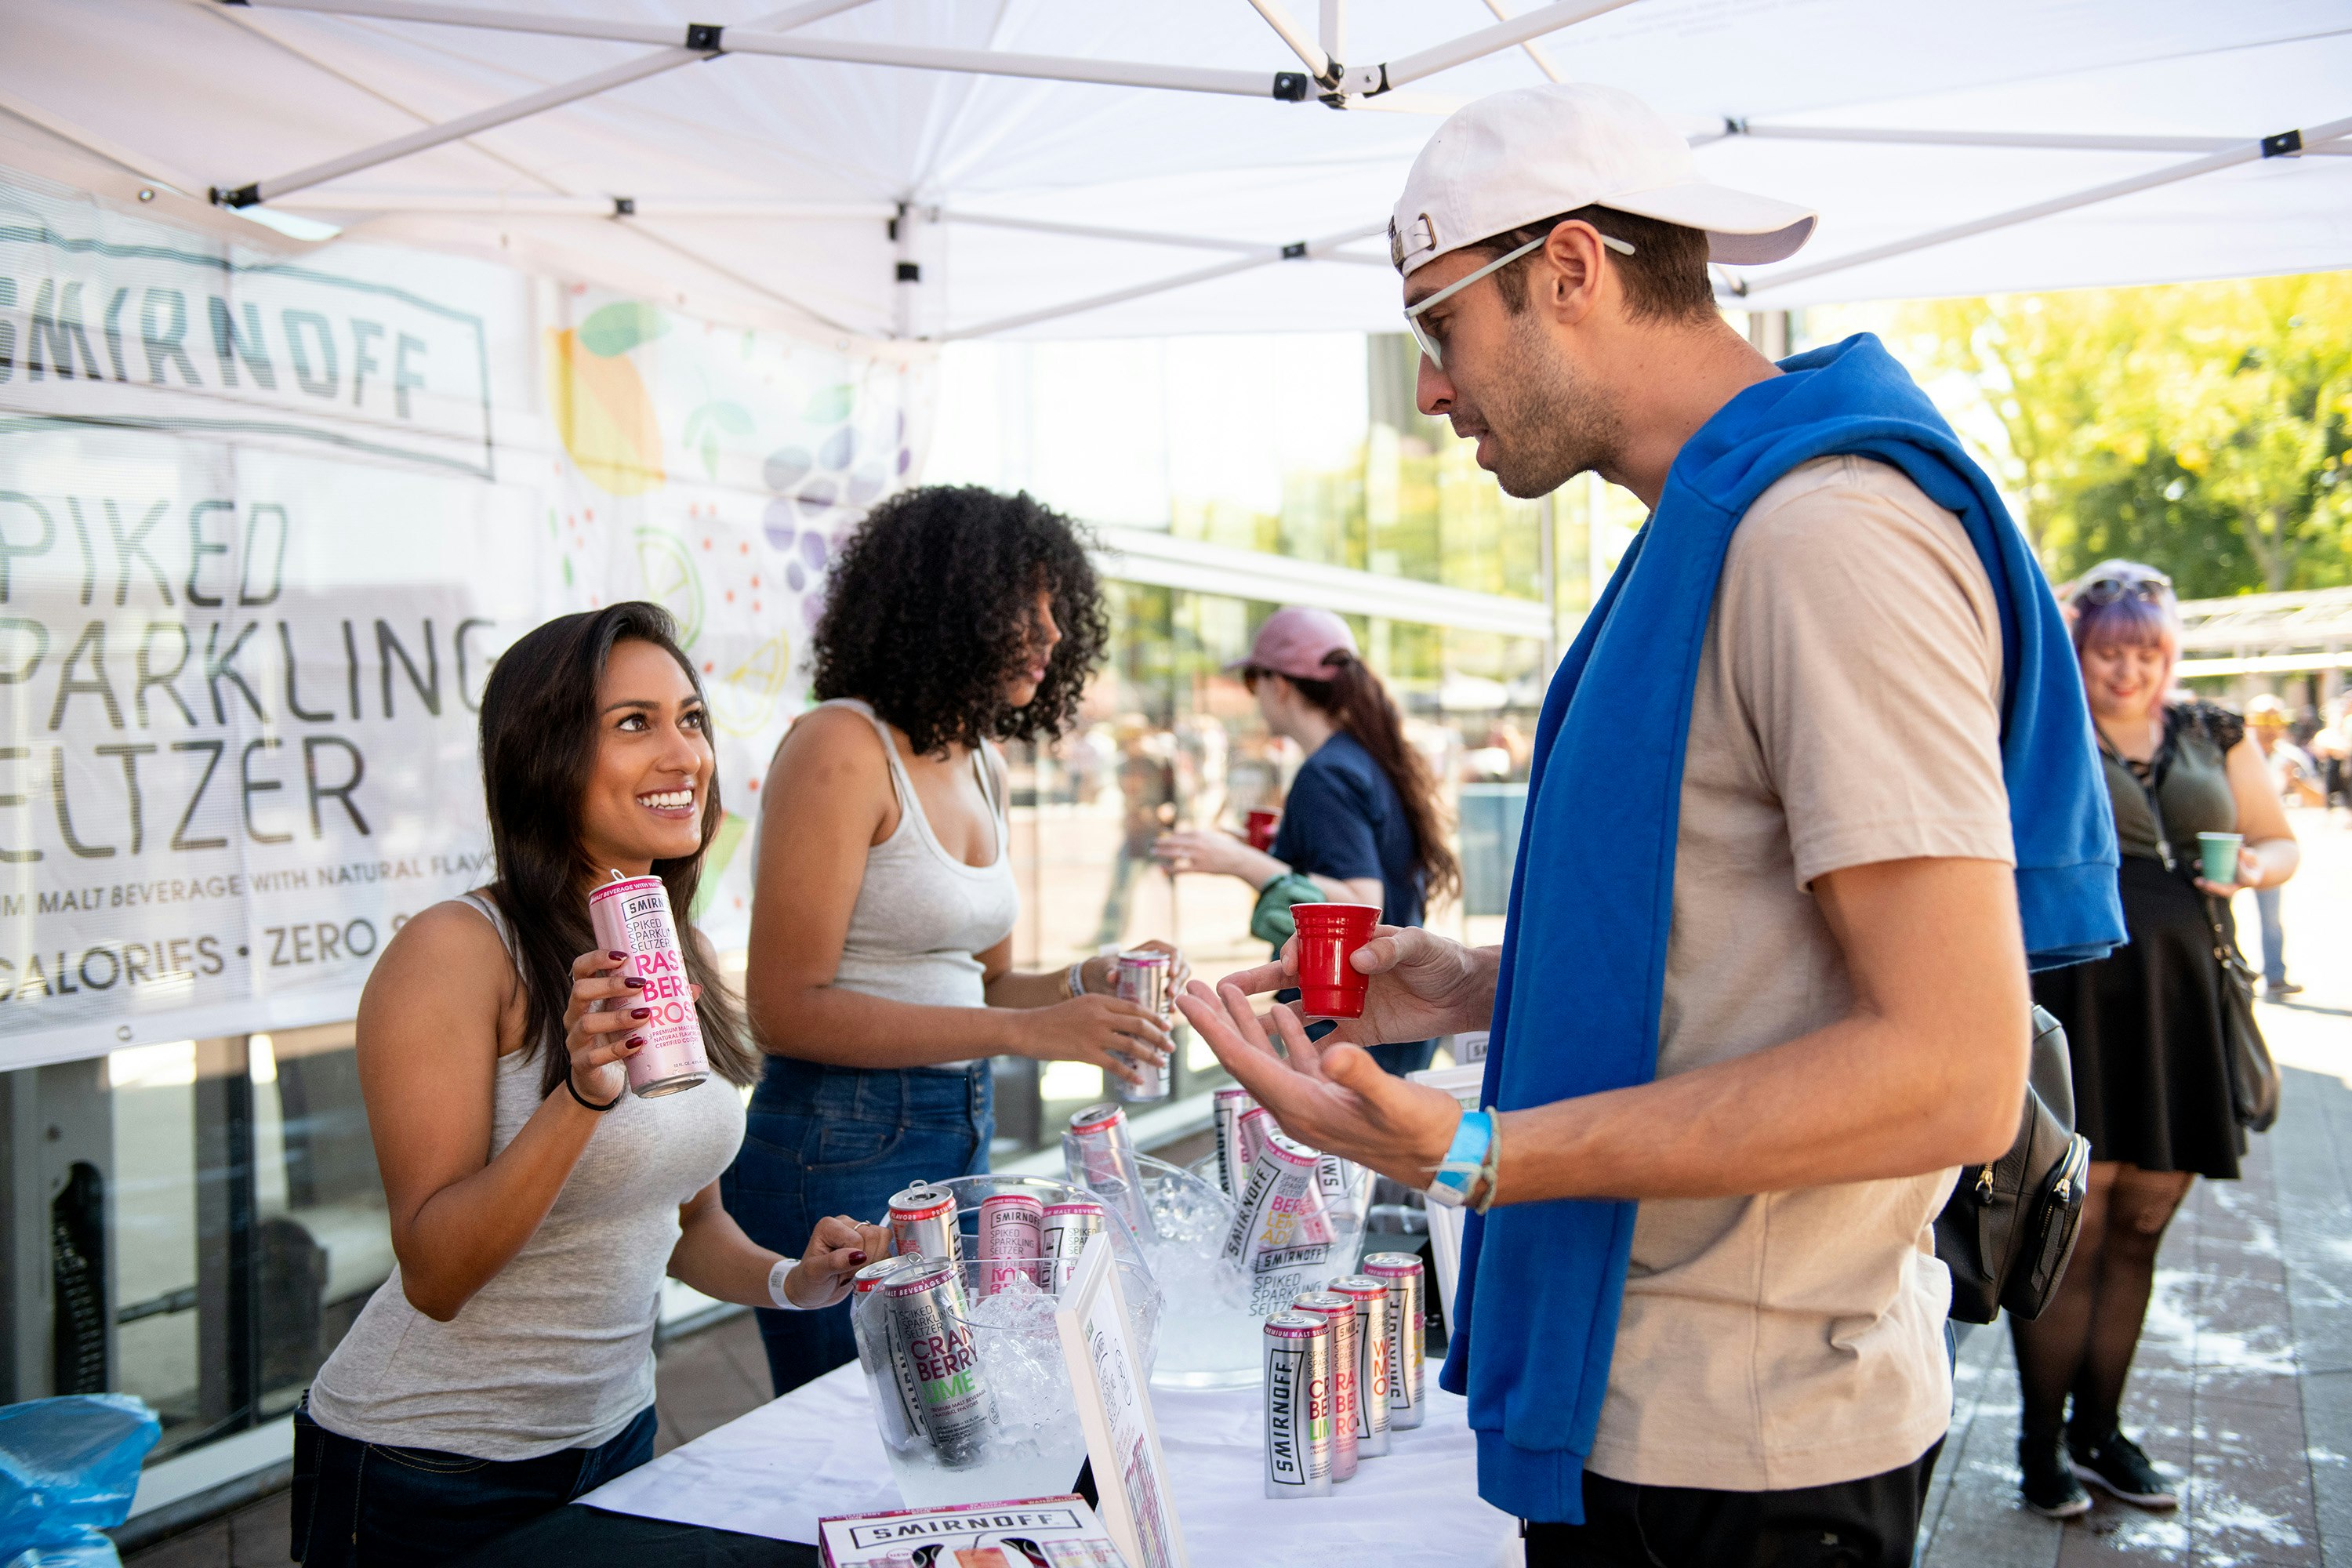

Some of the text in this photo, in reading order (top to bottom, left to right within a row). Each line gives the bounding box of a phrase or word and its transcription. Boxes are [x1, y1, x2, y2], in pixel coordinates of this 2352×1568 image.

[38, 887, 103, 913] MALT
[111, 875, 242, 908] BEVERAGE
[252, 872, 307, 892] WITH
[317, 858, 422, 884] NATURAL
[604, 884, 633, 898] BEVERAGE
[633, 880, 649, 891] WITH
[626, 918, 662, 934] SPIKED
[265, 919, 376, 967] ZERO
[630, 938, 671, 953] SELTZER
[635, 949, 681, 977] RAS
[652, 1027, 677, 1036] PREMIUM
[654, 1033, 679, 1043] NATURAL
[655, 1039, 682, 1049] CERTIFIED
[1228, 1167, 1269, 1257] SMIRNOFF
[990, 1229, 1019, 1239] SPIKED
[1068, 1227, 1097, 1236] SPIKED
[990, 1238, 1034, 1249] SPARKLING
[990, 1246, 1024, 1255] SELTZER
[1265, 1248, 1322, 1267] SMIRNOFF
[899, 1278, 942, 1297] BEVERAGE
[942, 1271, 953, 1281] WIT
[1256, 1272, 1301, 1290] SPIKED
[1251, 1281, 1322, 1303] SPARKLING
[902, 1305, 954, 1330] SPARKLING
[905, 1322, 944, 1340] SELTZER
[1264, 1327, 1289, 1338] PREMIUM
[910, 1325, 974, 1360] CRAN
[916, 1341, 978, 1382] BERRY
[952, 1399, 965, 1408] MALT
[957, 1400, 978, 1413] FLAVORS
[1309, 1397, 1330, 1420] BE
[1272, 1362, 1294, 1472] SMIRNOFF
[873, 1514, 1053, 1539] SMIRNOFF
